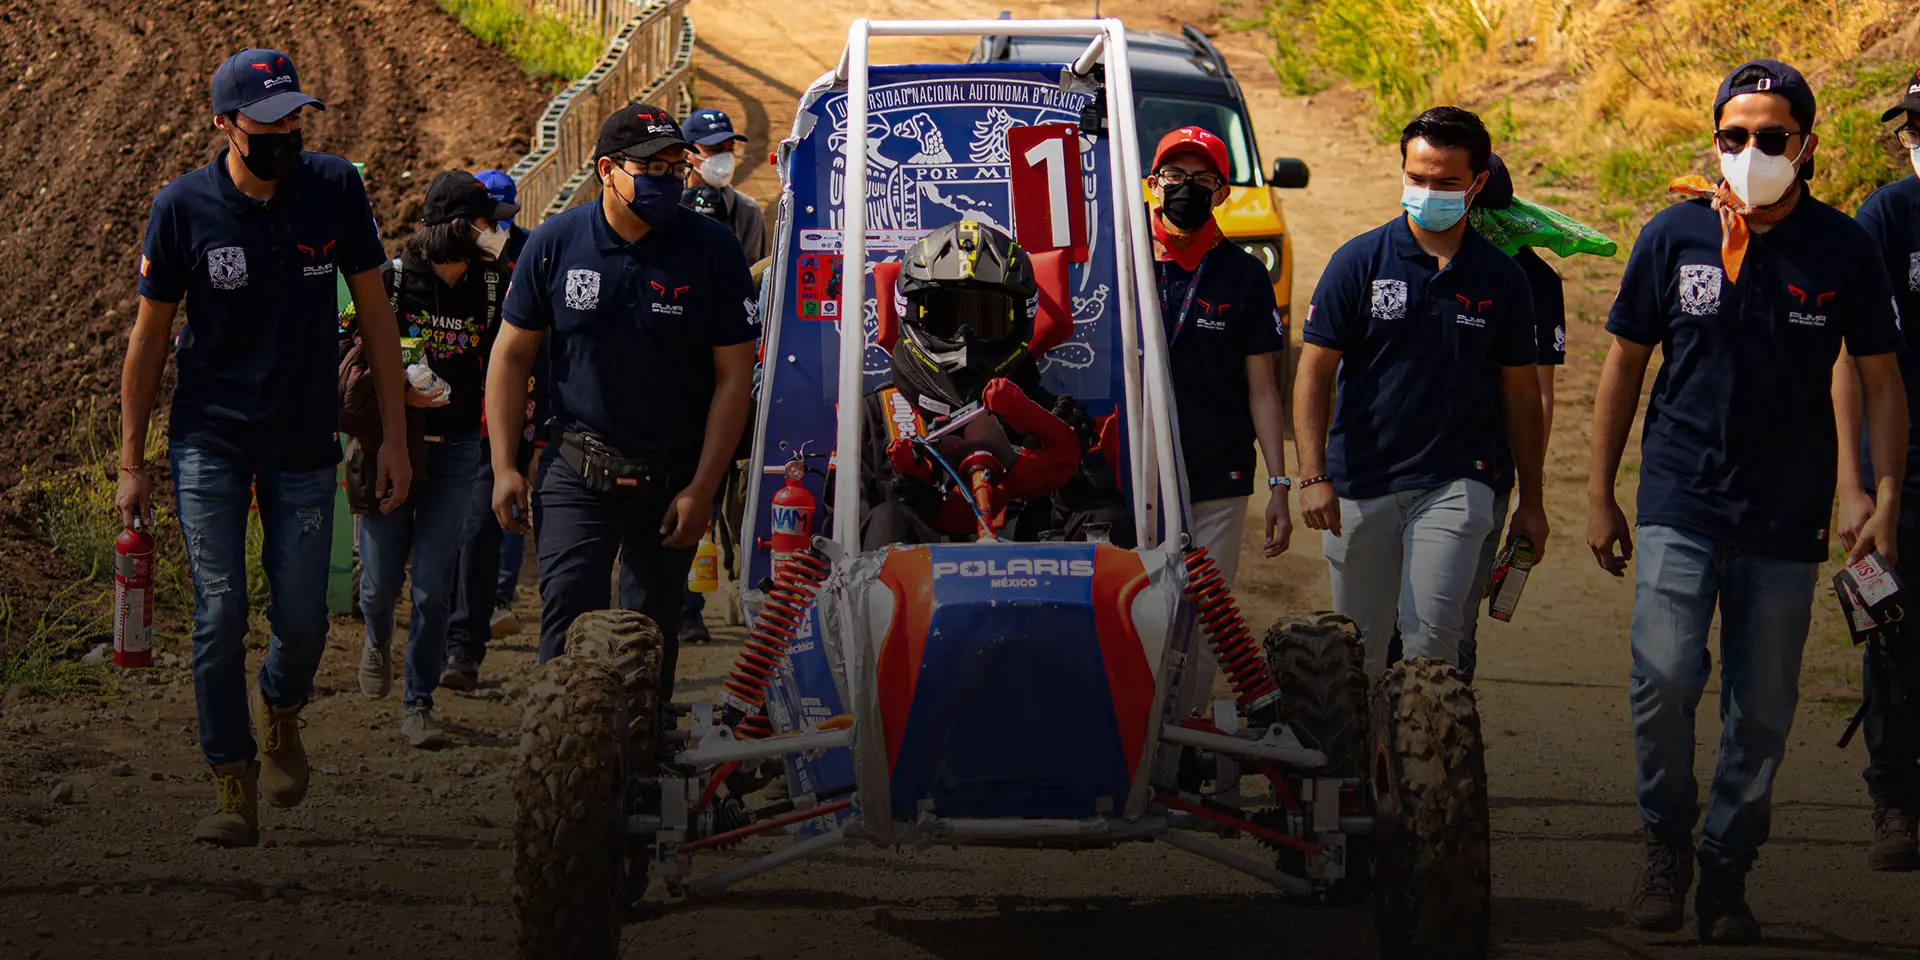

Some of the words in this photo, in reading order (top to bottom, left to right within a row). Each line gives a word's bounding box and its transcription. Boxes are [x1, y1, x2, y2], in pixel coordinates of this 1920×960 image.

[911, 84, 966, 104] NACIONAL
[969, 83, 1029, 103] AUTONOMA
[1042, 89, 1085, 112] MEXICO
[916, 167, 959, 180] POR
[1024, 138, 1071, 247] 1
[304, 263, 332, 271] PUMA
[652, 303, 683, 311] PUMA
[432, 313, 463, 330] VANS
[1789, 312, 1826, 321] PUMA
[932, 558, 1095, 580] POLARIS
[990, 577, 1038, 588] MÉXICO
